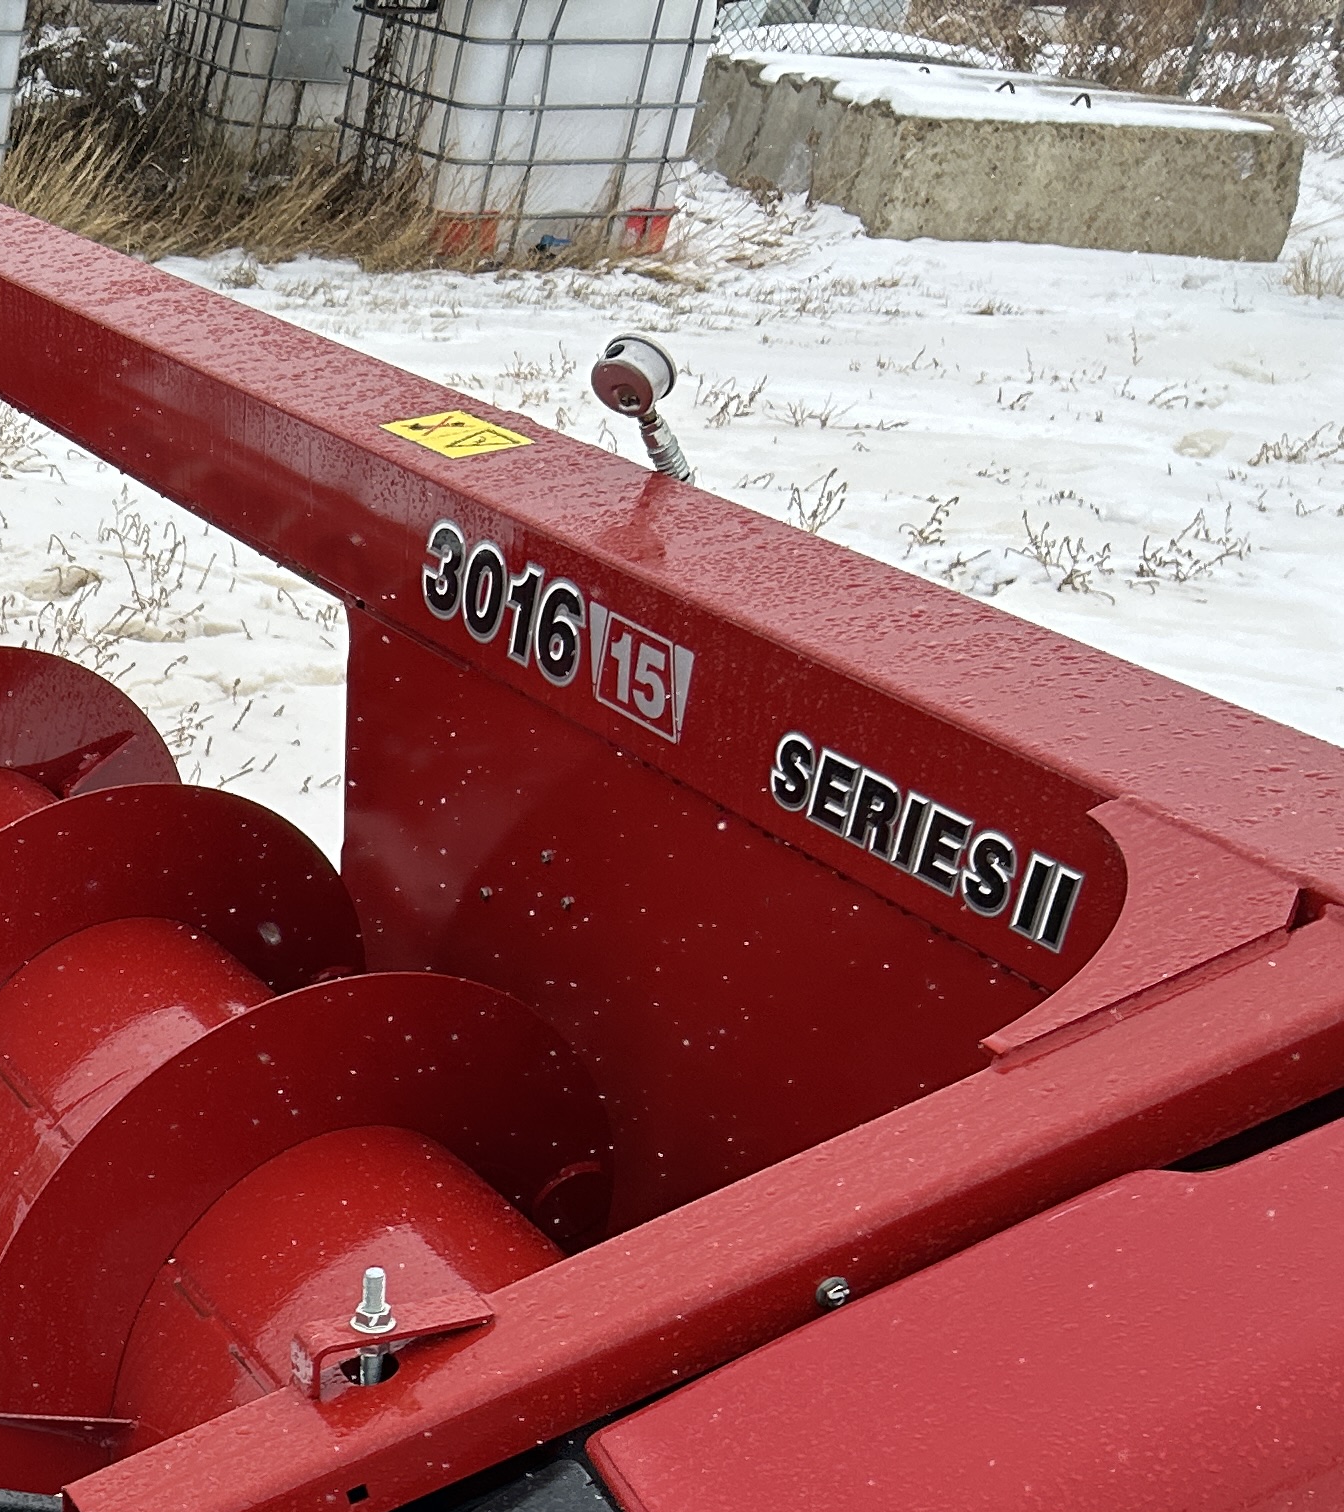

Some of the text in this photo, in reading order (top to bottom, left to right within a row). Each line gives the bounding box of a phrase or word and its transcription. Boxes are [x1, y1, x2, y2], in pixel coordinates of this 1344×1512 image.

[422, 518, 666, 720] 3016 15
[770, 731, 1085, 954] SERIES II
